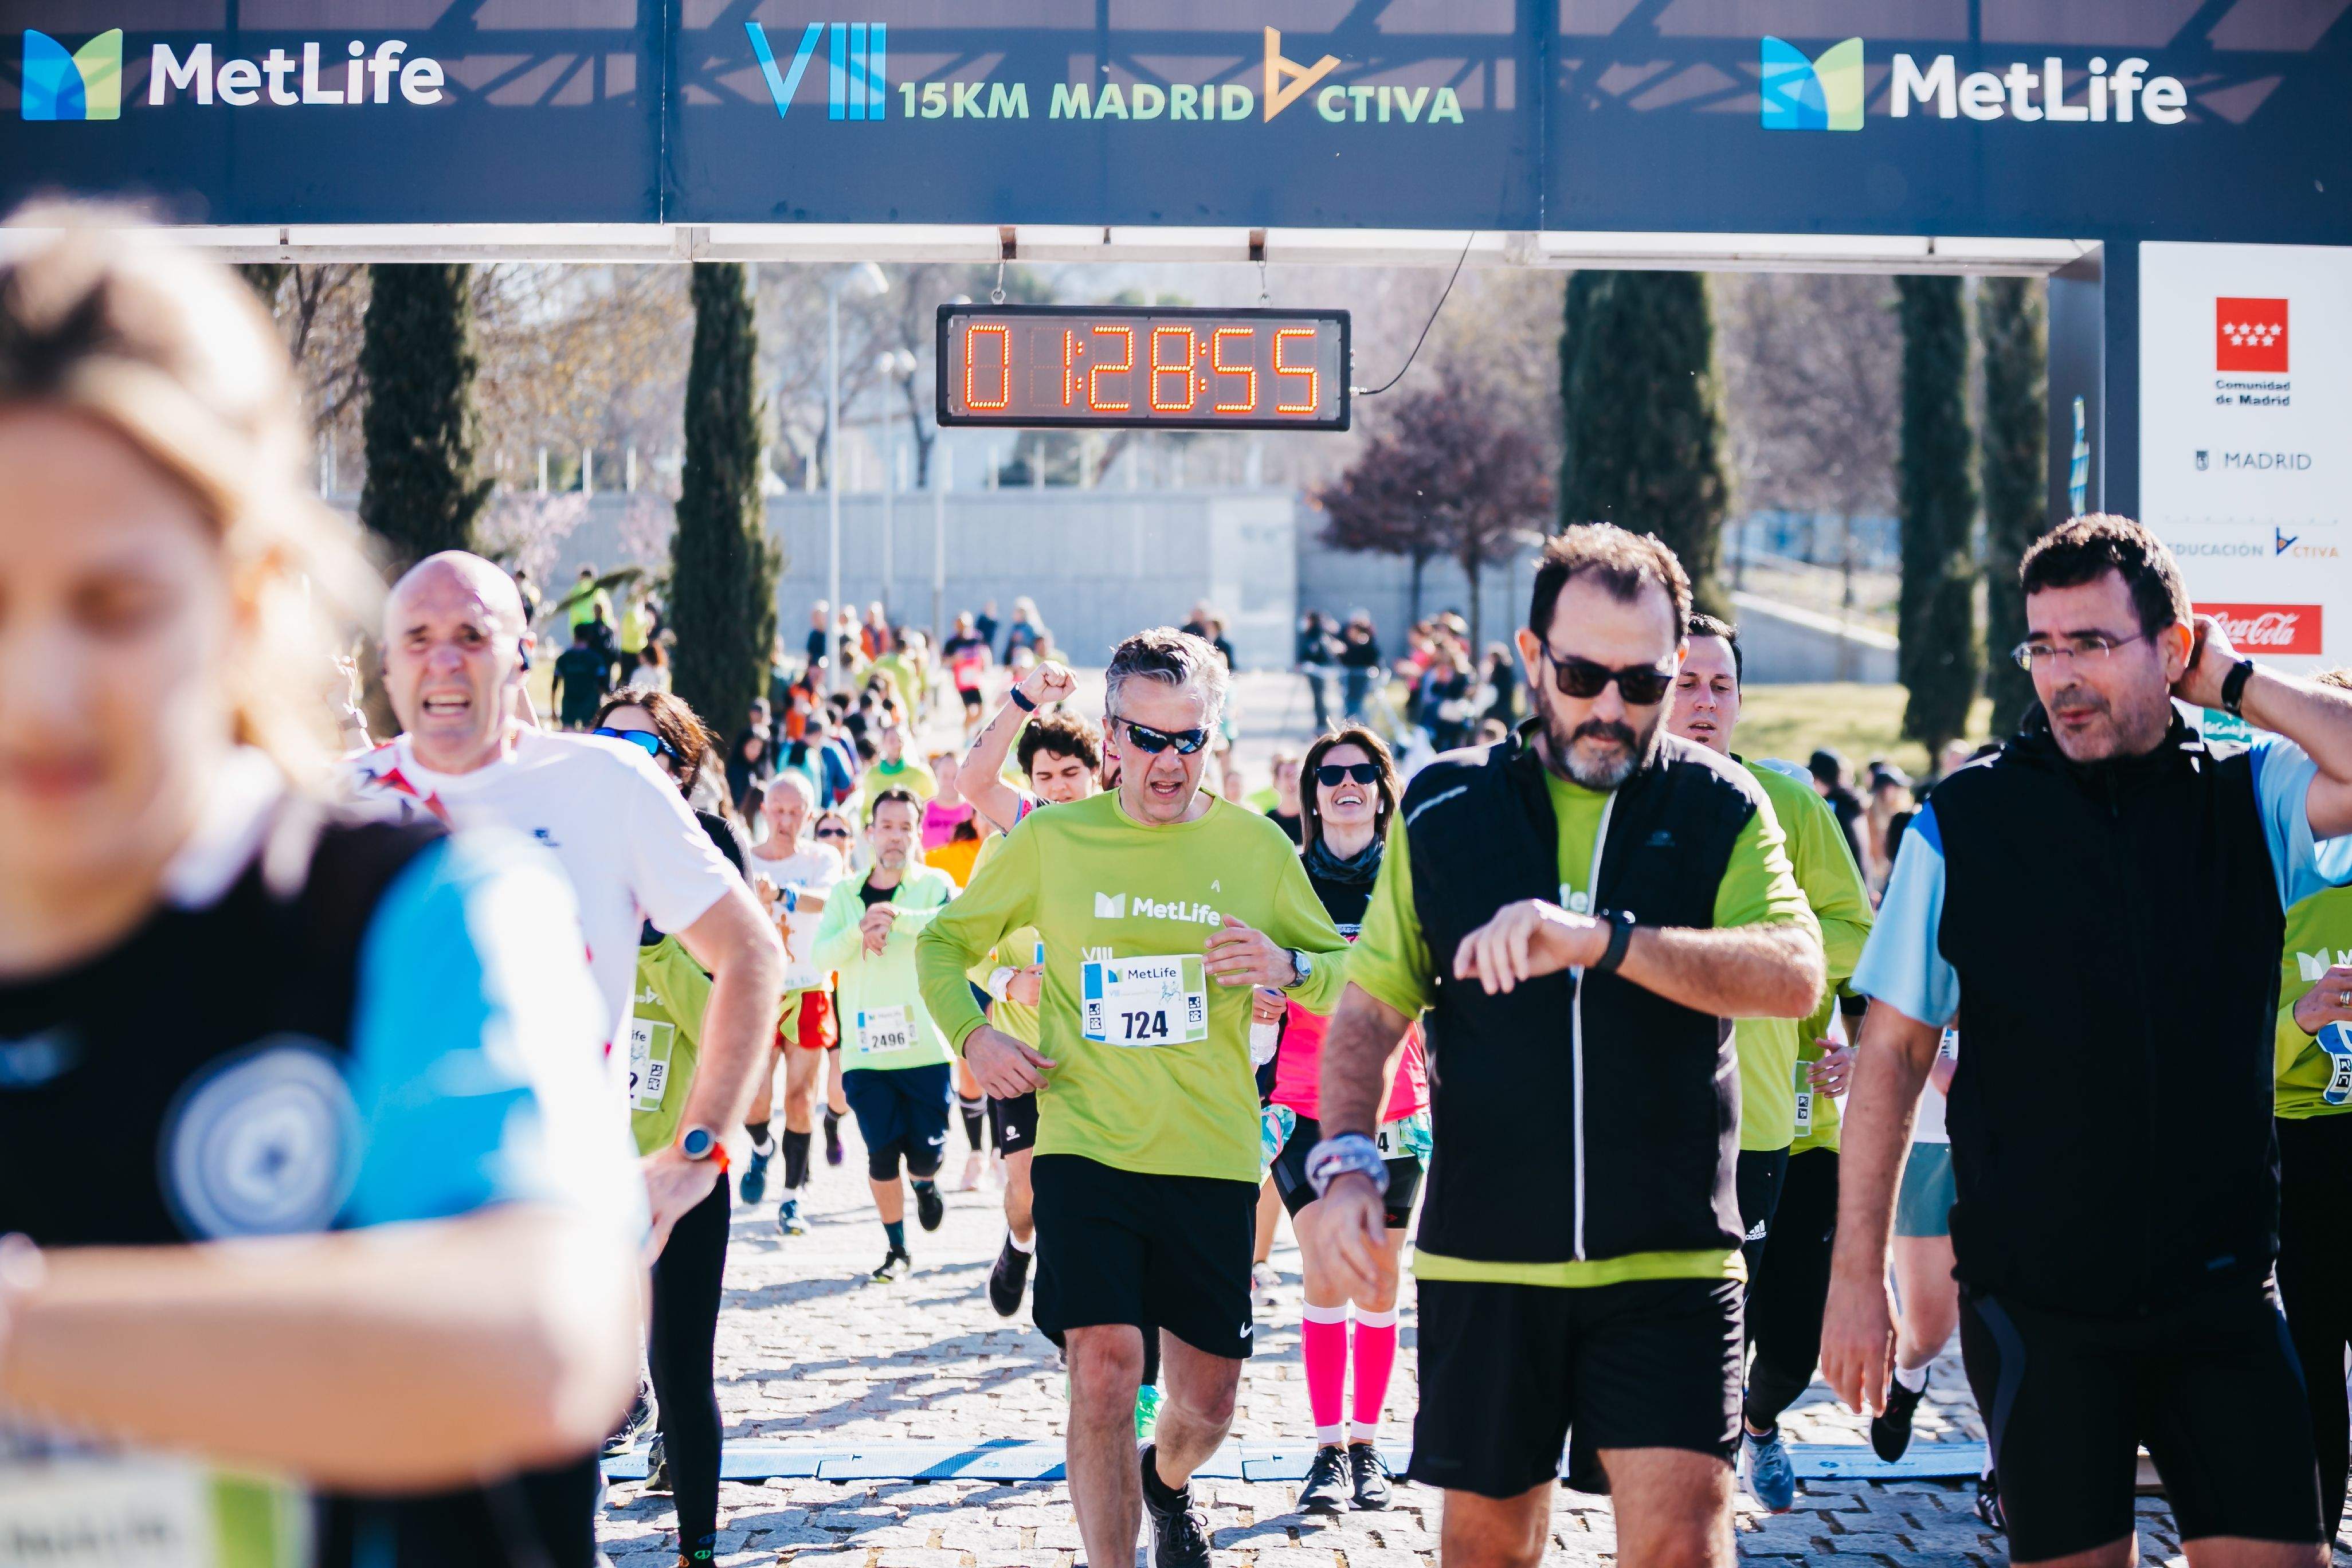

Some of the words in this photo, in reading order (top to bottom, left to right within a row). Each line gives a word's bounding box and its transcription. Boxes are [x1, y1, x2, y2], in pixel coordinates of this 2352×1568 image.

[148, 40, 444, 106] MetLife
[745, 22, 886, 120] VIII
[898, 82, 1030, 119] 15KM
[1049, 83, 1255, 120] MADRID
[1891, 54, 2188, 124] MetLife
[2216, 379, 2291, 391] Comunidad
[2216, 394, 2232, 405] de
[2239, 395, 2291, 406] Madrid
[2225, 452, 2312, 470] MADRID
[1132, 897, 1221, 926] MetLife
[1128, 967, 1177, 979] MetLife
[1121, 1011, 1169, 1040] 724
[872, 1032, 905, 1049] 2496
[1745, 1232, 1767, 1240] adidas
